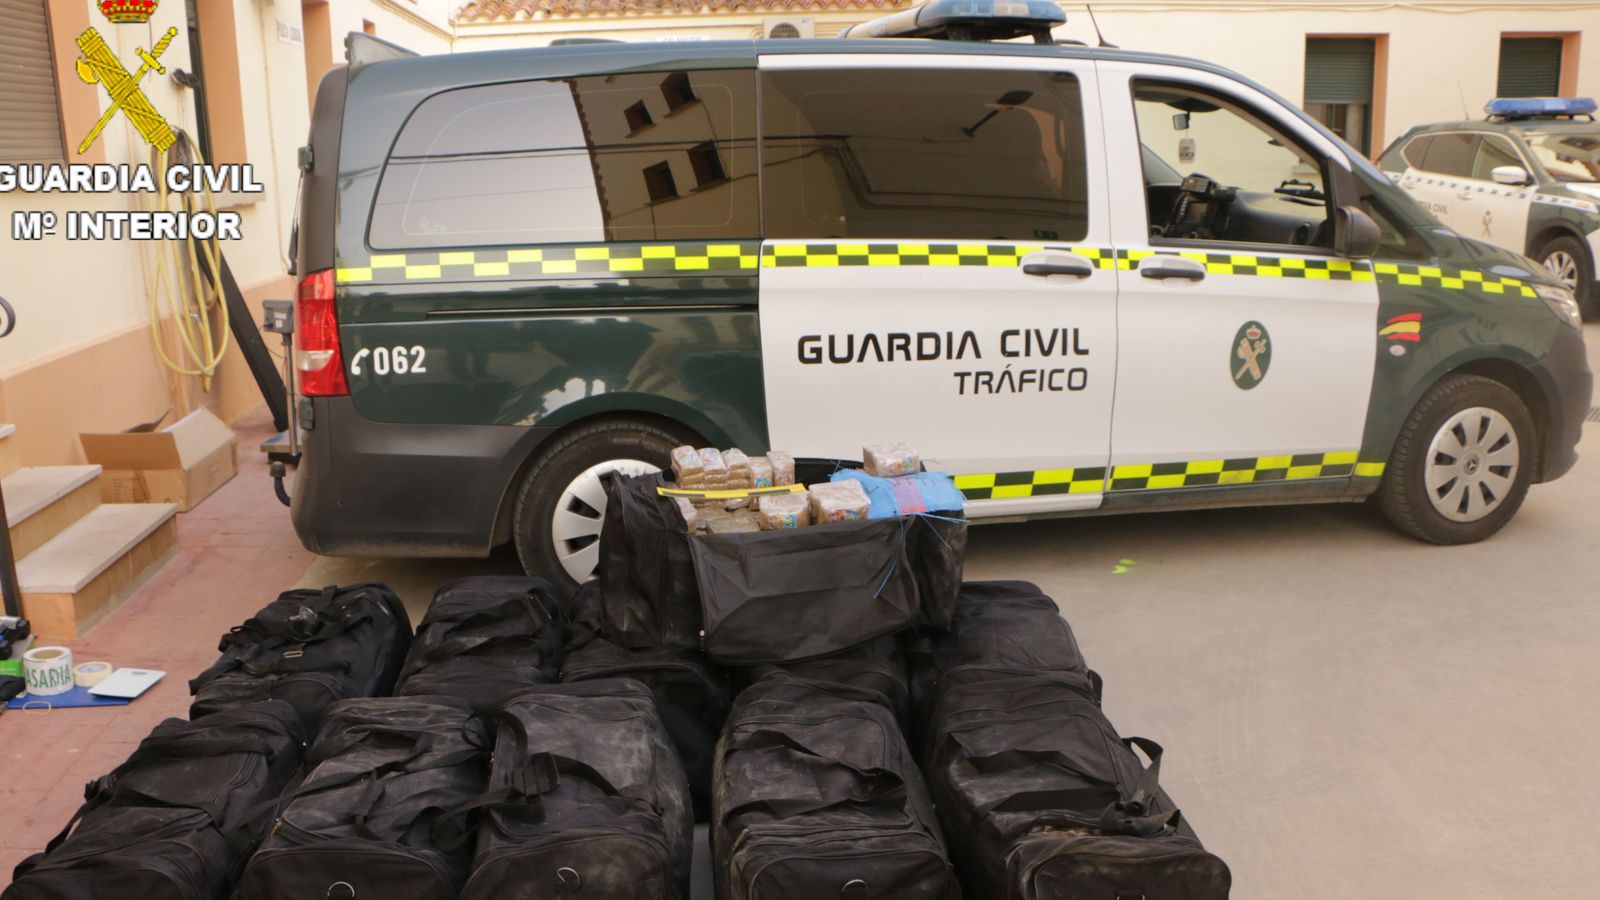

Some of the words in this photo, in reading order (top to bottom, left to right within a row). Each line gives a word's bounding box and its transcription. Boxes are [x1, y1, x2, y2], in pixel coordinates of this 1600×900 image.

[373, 345, 427, 375] 062
[797, 330, 983, 364] GUARDIA
[1000, 328, 1089, 357] CIVIL
[953, 363, 1088, 395] TRÁFICO
